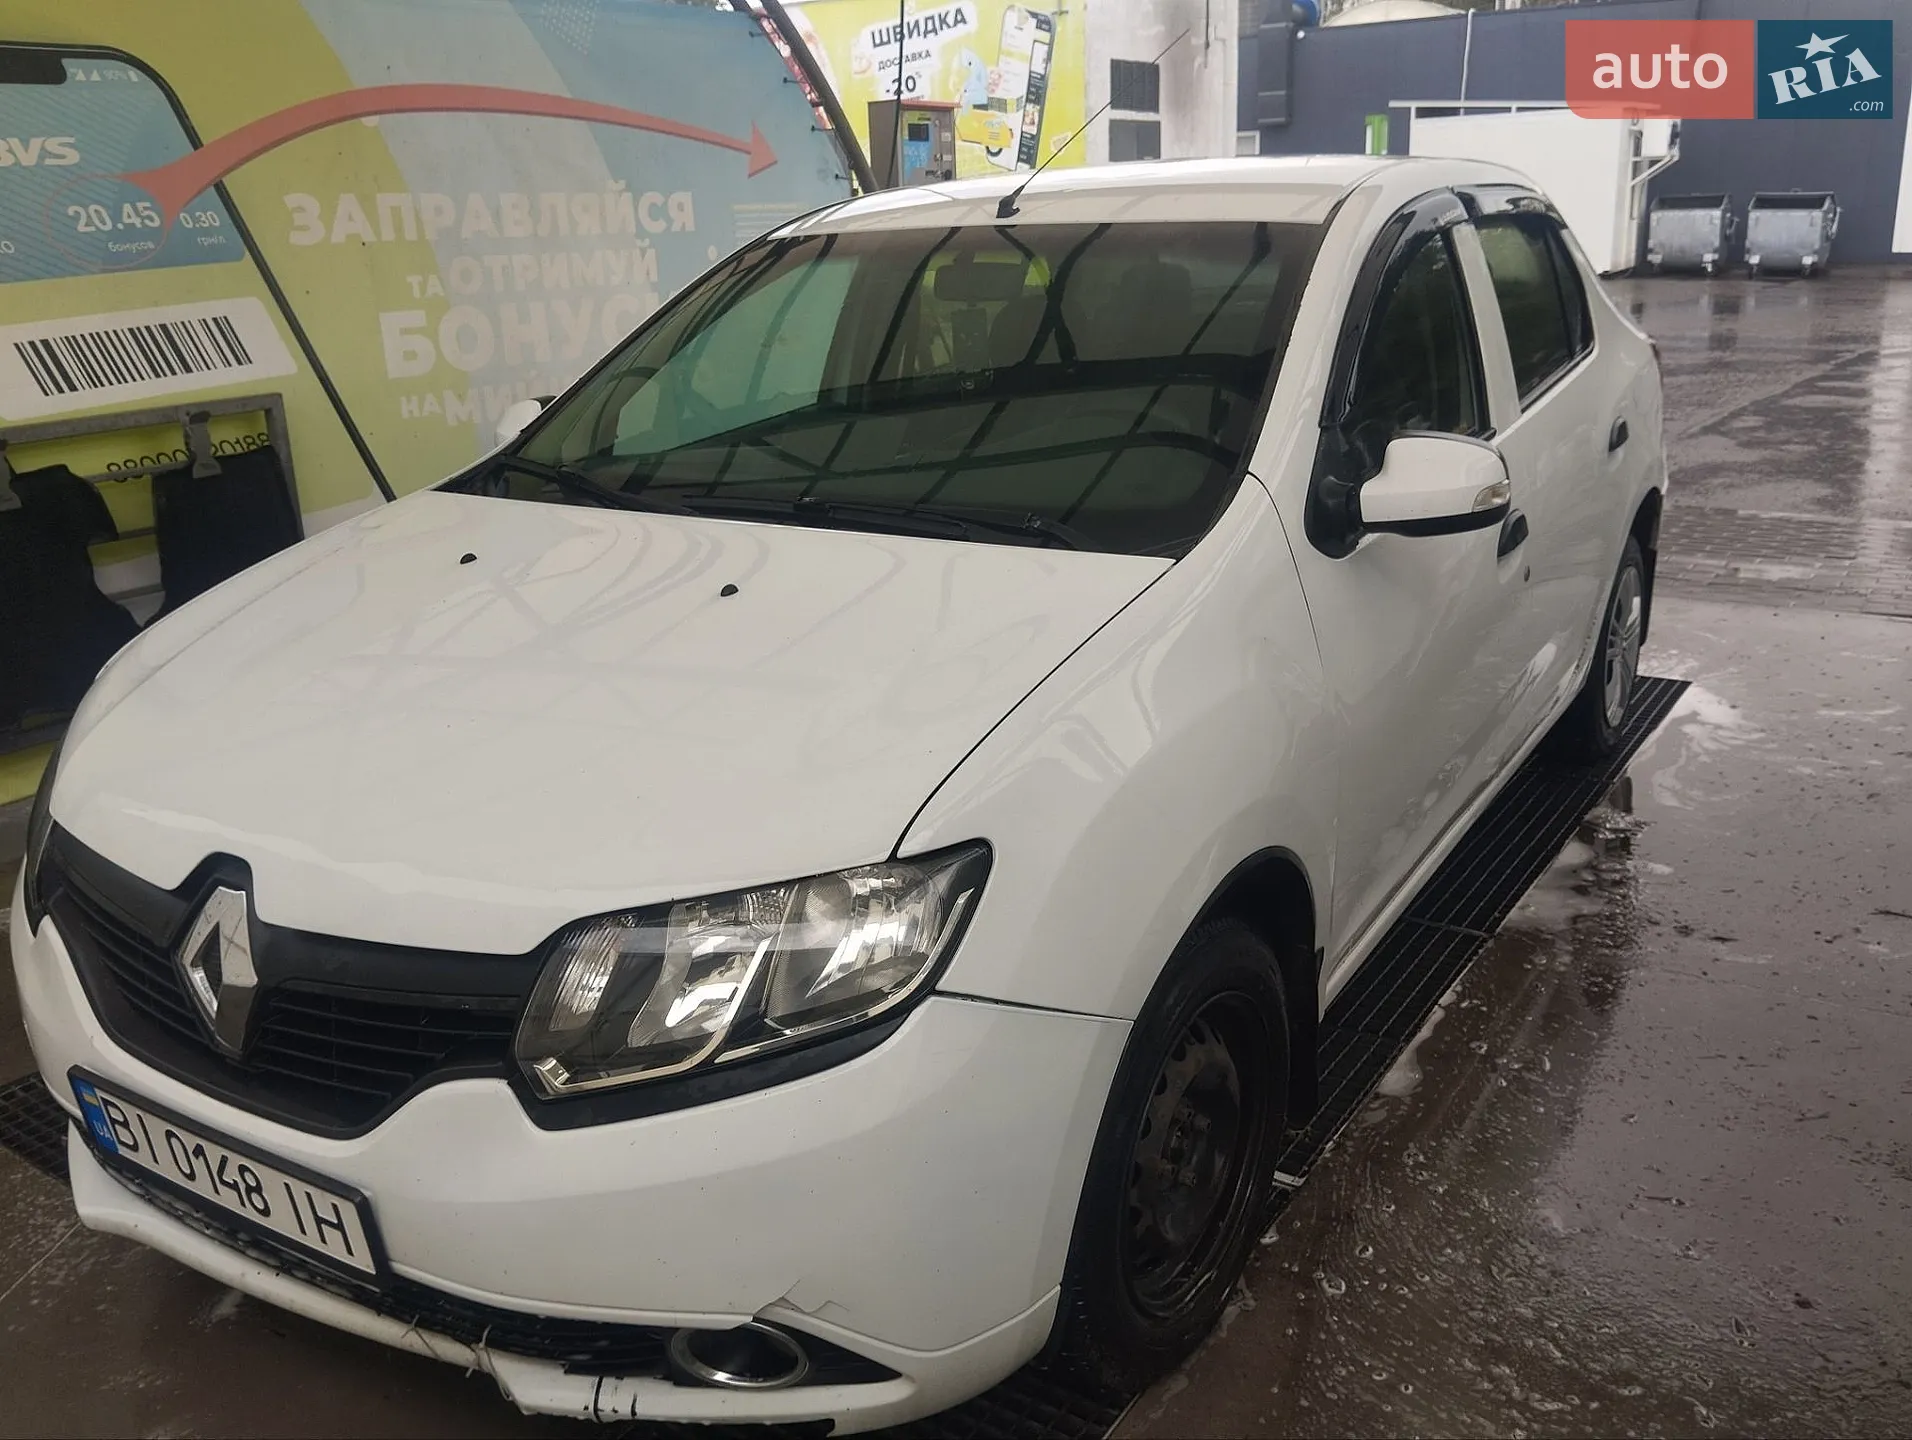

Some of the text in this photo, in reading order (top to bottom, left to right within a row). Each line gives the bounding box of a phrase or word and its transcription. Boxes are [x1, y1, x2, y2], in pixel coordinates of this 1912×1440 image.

[871, 7, 967, 48] ШВИДКА
[878, 49, 932, 72] ДОСАВКА
[67, 201, 220, 232] 20.45 0.30
[283, 179, 696, 246] ЗАПРАВЛЯЙСЯ
[451, 238, 659, 296] ОТРИМУЙ
[99, 1095, 355, 1258] BI 0148 IH
